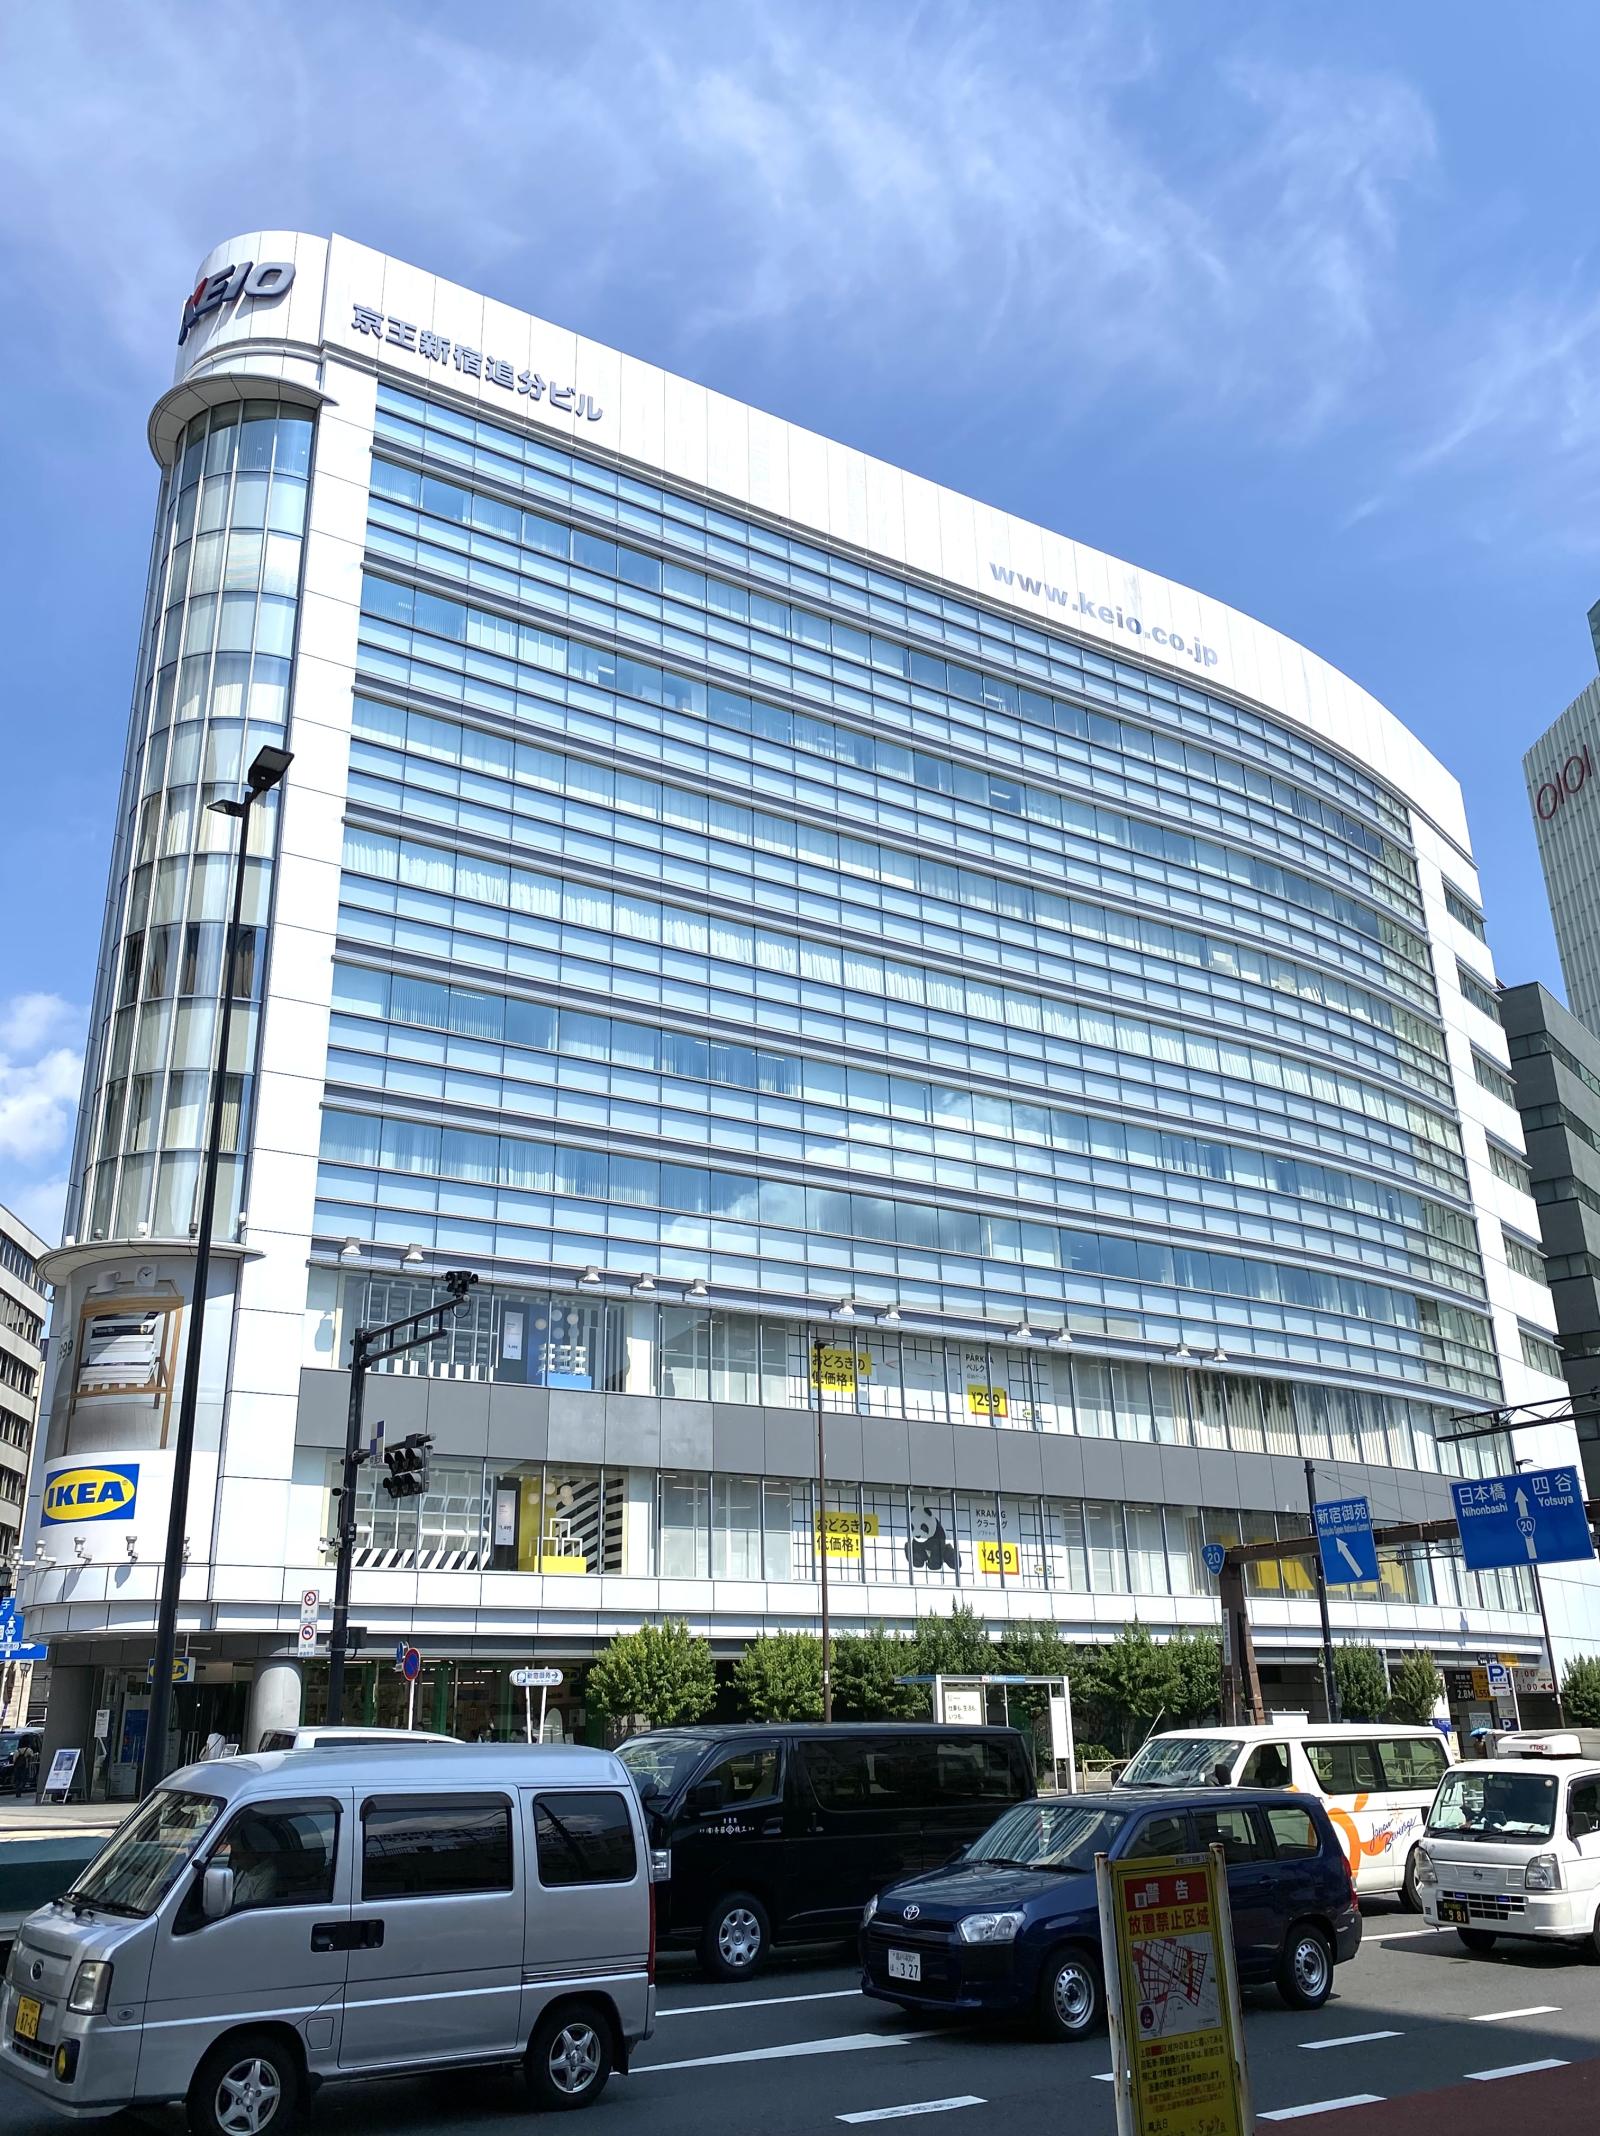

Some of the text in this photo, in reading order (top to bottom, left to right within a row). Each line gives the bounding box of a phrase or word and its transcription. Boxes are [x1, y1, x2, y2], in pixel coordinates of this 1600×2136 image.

[178, 261, 296, 346] KEIO
[350, 302, 604, 422] 京王新宿追分ビル
[989, 561, 1218, 667] www.keio.co.jp
[965, 1353, 994, 1364] PÄRKA
[1458, 1482, 1506, 1505] 日本橋
[1532, 1473, 1572, 1495] 四谷
[47, 1481, 125, 1510] IKEA
[1538, 1495, 1574, 1507] Yotsuya
[976, 1508, 1006, 1519] KRAMG
[1316, 1503, 1367, 1525] 新宿御苑
[1462, 1502, 1508, 1517] Nihonbashi
[976, 1519, 1008, 1529] クラーグ
[1520, 1520, 1533, 1532] 20
[1207, 1552, 1221, 1565] 20
[1128, 1907, 1209, 1936] 放置禁止区域
